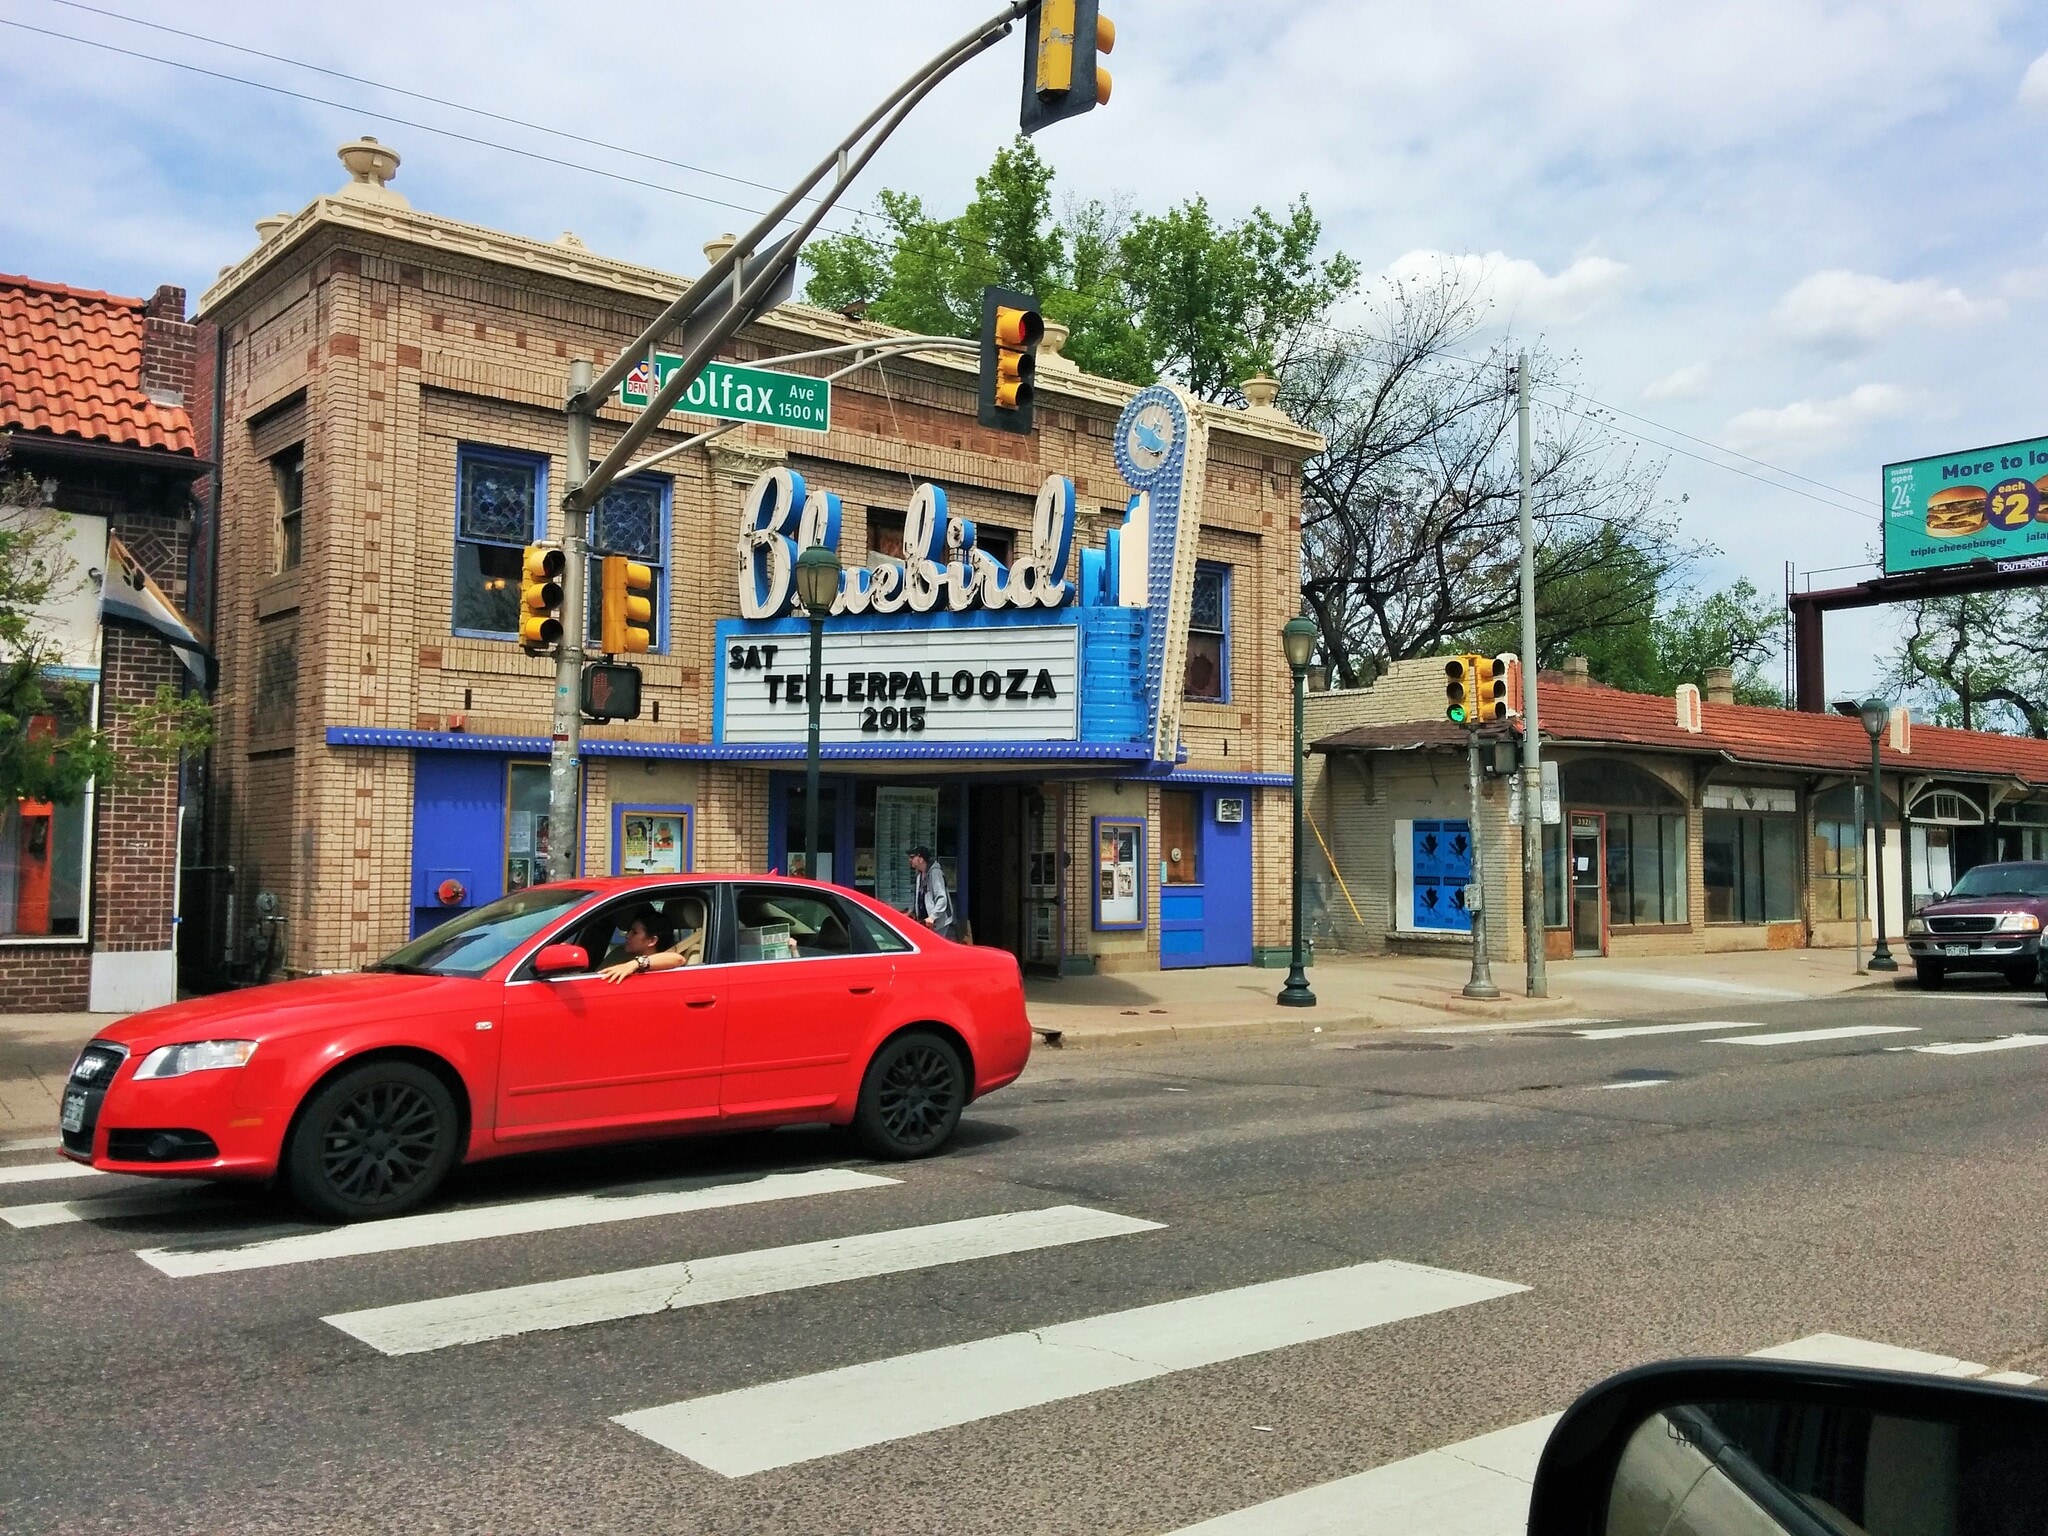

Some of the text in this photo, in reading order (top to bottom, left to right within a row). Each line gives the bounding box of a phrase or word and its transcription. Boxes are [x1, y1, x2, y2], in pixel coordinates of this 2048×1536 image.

[628, 381, 660, 396] DENVR
[789, 384, 815, 401] Ave
[779, 403, 824, 422] 1500 N
[1942, 460, 1995, 480] More
[2001, 456, 2023, 470] to
[1891, 474, 1913, 484] open
[1998, 481, 2026, 494] each
[1891, 484, 1911, 510] 24
[1992, 493, 2029, 525] $2
[737, 466, 1075, 619] Bluebird
[1910, 537, 2008, 557] triple cheeseburger
[2027, 532, 2048, 543] jala
[729, 645, 778, 670] SAT
[861, 706, 926, 732] 2015
